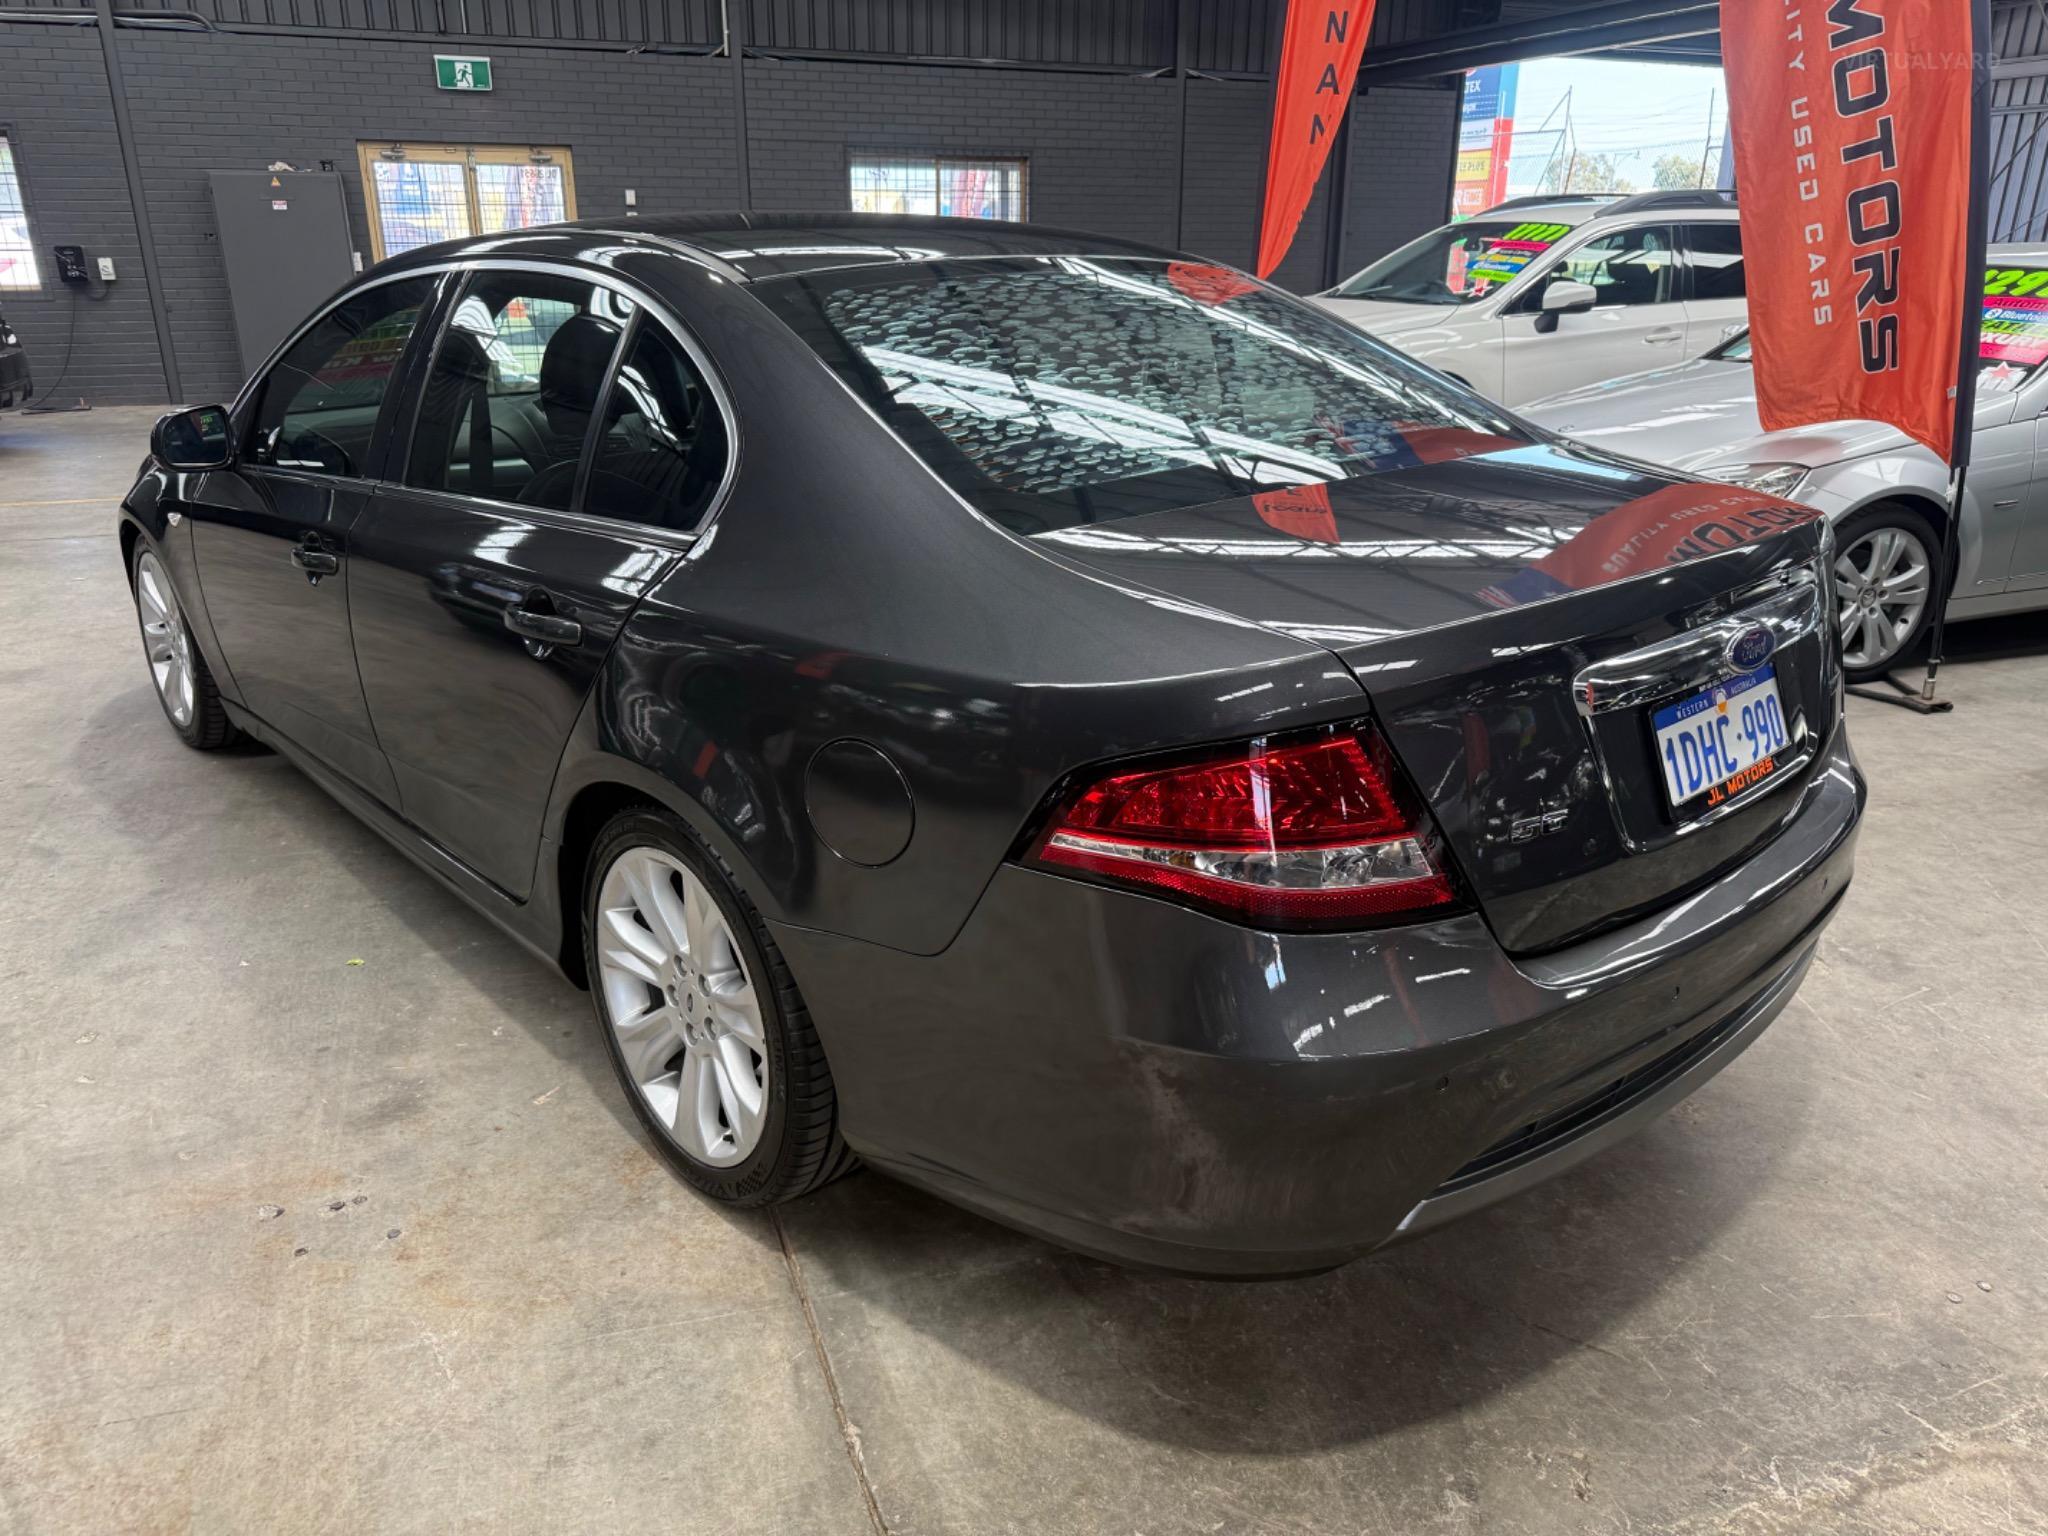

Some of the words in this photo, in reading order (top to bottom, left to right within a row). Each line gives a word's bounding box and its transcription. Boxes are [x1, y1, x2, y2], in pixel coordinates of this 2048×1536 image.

[1790, 96, 1819, 200] USED
[1804, 222, 1832, 325] CARS
[1707, 786, 1725, 806] JL
[1726, 756, 1774, 795] MOTORS
